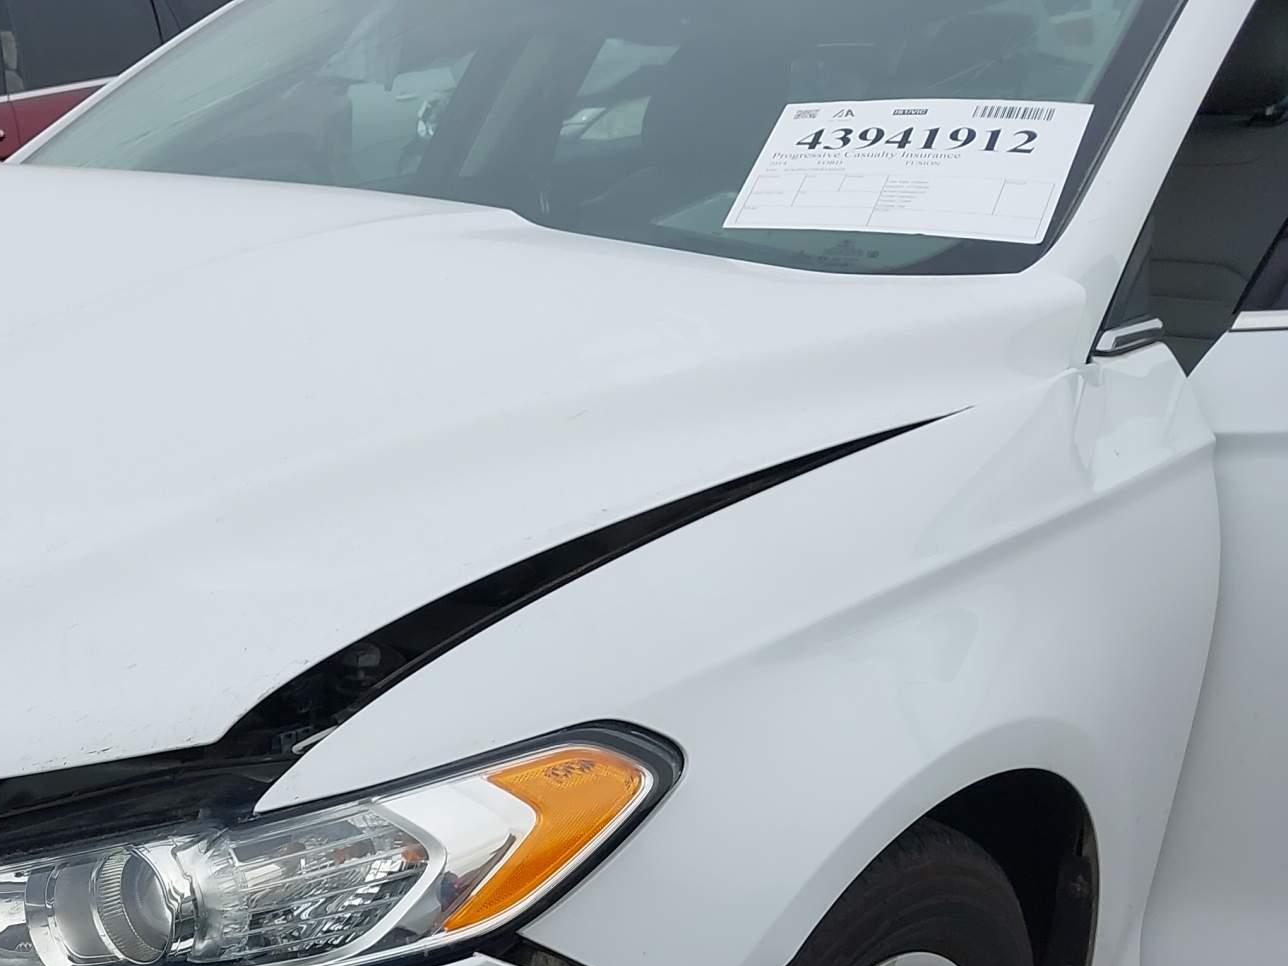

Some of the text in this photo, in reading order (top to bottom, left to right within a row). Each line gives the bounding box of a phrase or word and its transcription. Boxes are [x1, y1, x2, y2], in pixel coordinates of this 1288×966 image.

[795, 127, 1038, 154] 43941912
[772, 150, 961, 161] Progressive Casualty Insurance
